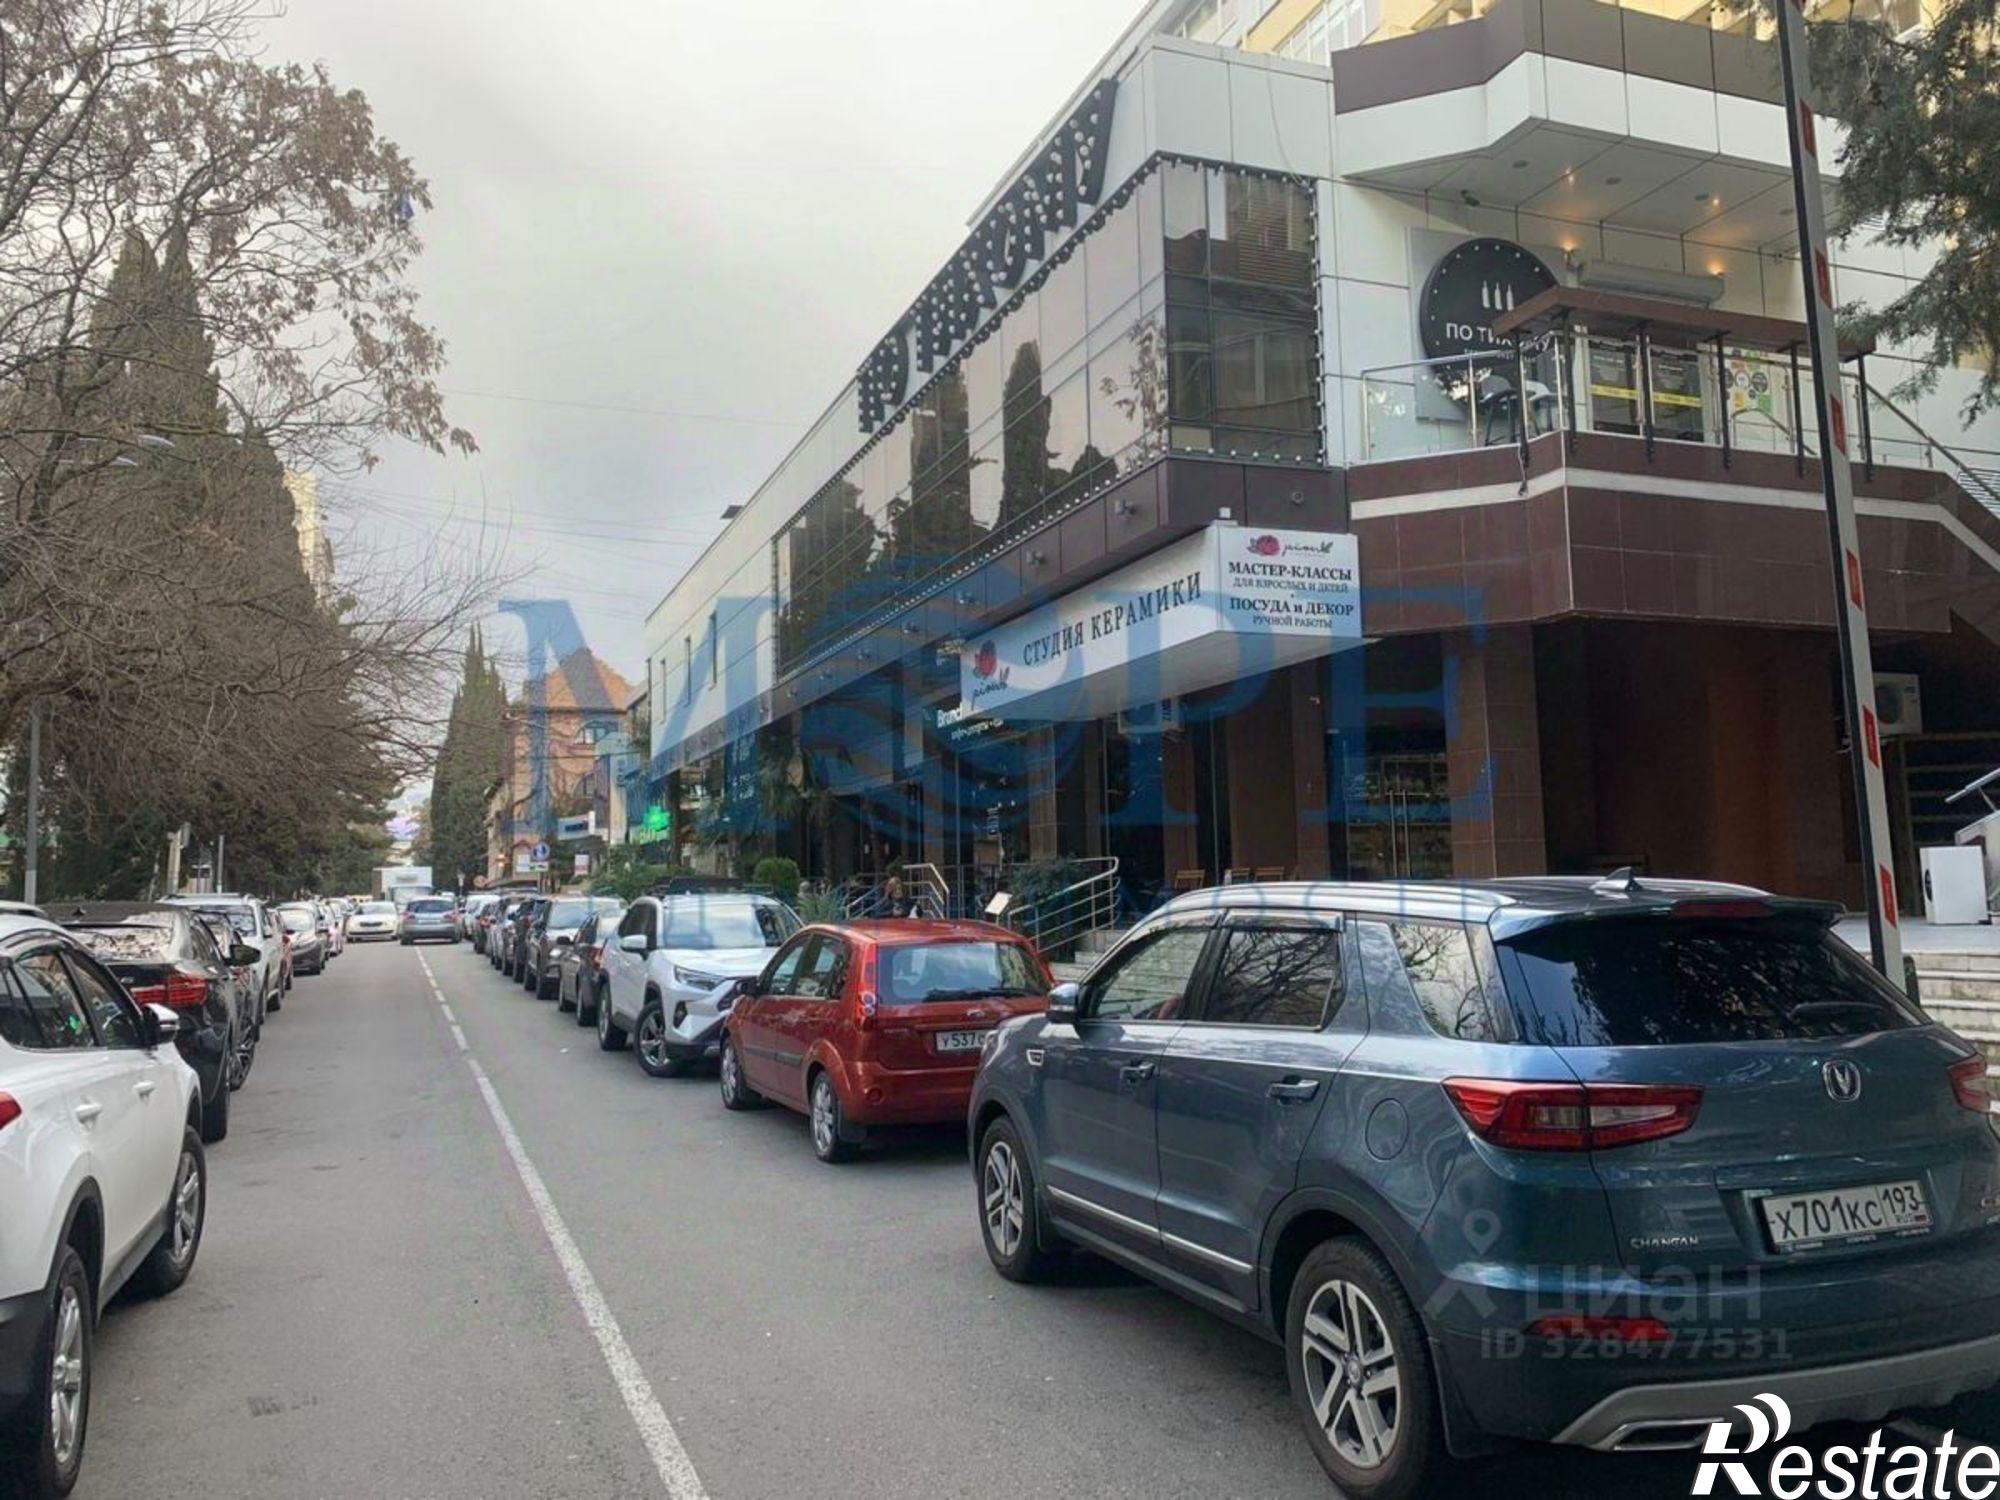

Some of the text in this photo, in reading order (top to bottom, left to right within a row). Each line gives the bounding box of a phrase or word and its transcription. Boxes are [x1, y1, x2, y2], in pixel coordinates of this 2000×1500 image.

[1446, 322, 1473, 341] ПО
[1229, 561, 1352, 581] МАСТЕР-КЛАССЫ
[1233, 577, 1348, 594] ДЛЯ ВЗРОСЛЫХ И ДЕТЕЙ
[1230, 597, 1291, 614] ПОСУДА
[1305, 602, 1355, 617] ДЕКОР
[1022, 621, 1084, 667] СТУДИЯ
[1091, 571, 1202, 641] КЕРАМИКИ
[1252, 614, 1333, 629] РУЧНОЙ РАБОТЫ
[1882, 1185, 1920, 1214] 193
